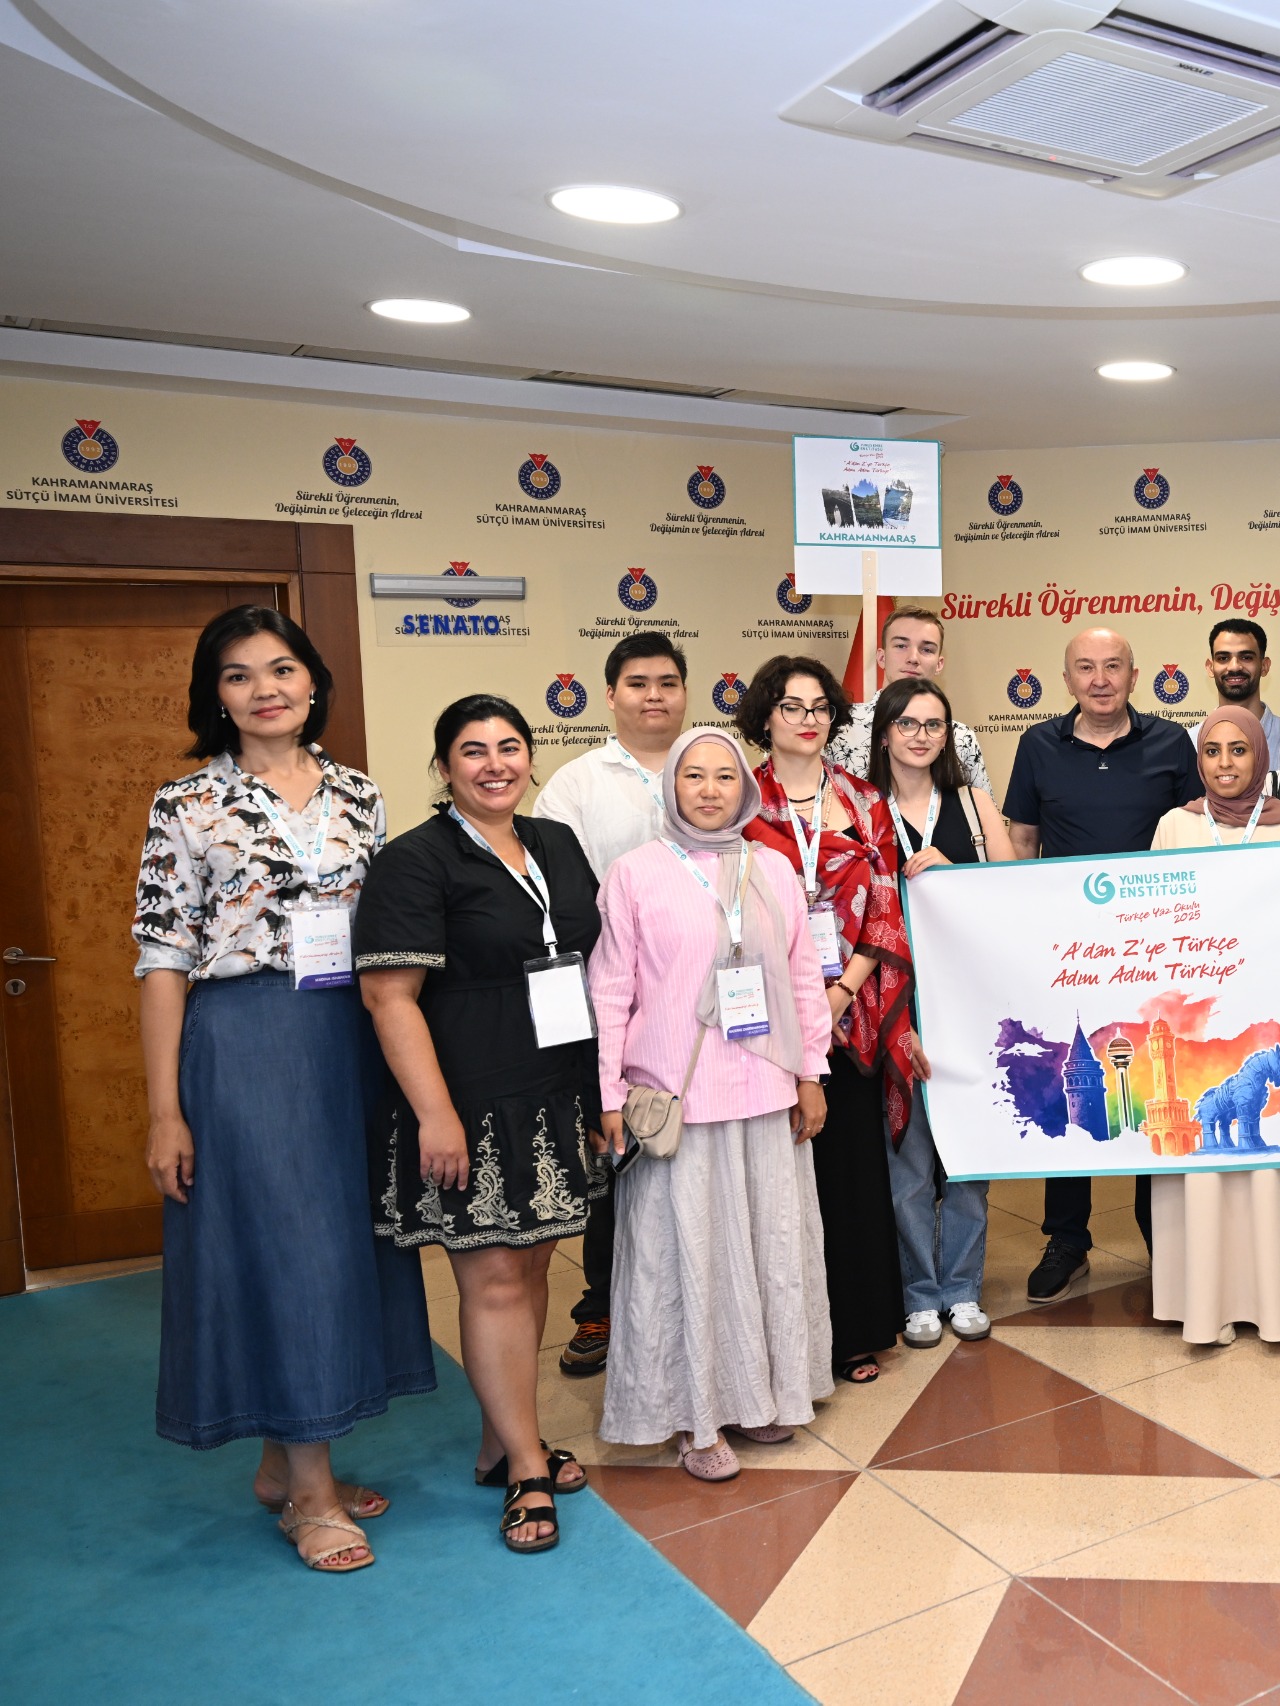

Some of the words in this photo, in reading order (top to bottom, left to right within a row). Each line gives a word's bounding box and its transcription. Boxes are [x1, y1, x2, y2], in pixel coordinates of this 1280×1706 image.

[32, 477, 153, 494] KAHRAMANMARAŞ
[7, 489, 49, 503] SÜTÇÜ
[54, 491, 91, 503] İMAM
[96, 494, 178, 508] ÜNİVERSİTESİ
[296, 491, 333, 502] Sürekli
[335, 491, 399, 506] Öğrenmenin,
[275, 503, 327, 516] Değişimin
[342, 506, 388, 520] Geleceğin
[391, 509, 422, 519] Adresi
[496, 504, 586, 518] KAHRAMANMARAŞ
[1115, 513, 1191, 523] KAHRAMANMARAŞ
[477, 514, 509, 526] SÜTÇÜ
[512, 516, 540, 526] İMAM
[543, 517, 605, 529] ÜNİVERSİTESİ
[666, 513, 695, 522] Sürekli
[697, 514, 746, 525] Öğrenmenin,
[969, 522, 995, 530] Sürekli
[650, 523, 690, 535] Değişimin
[702, 526, 738, 538] Geleceğin
[740, 528, 765, 537] Adresi
[1100, 526, 1125, 536] SÜTÇÜ
[1128, 526, 1151, 534] İMAM
[1154, 522, 1207, 533] ÜNİVERSİTESİ
[819, 532, 917, 544] KAHRAMANMARAŞ
[954, 533, 990, 543] Değişimin
[1001, 531, 1034, 541] Geleceğin
[1036, 530, 1060, 539] Adresi
[940, 592, 1032, 621] Sürekli
[1038, 583, 1203, 624] Öğrenmenin,
[403, 614, 500, 635] SENATO
[596, 617, 626, 626] Sürekli
[628, 615, 680, 629] Öğrenmenin,
[758, 619, 833, 629] KAHRAMANMARAŞ
[579, 628, 620, 639] Değişimin
[673, 629, 699, 639] Adresi
[742, 629, 769, 640] SÜTÇÜ
[771, 629, 795, 638] İMAM
[797, 629, 849, 639] ÜNİVERSİTESİ
[556, 721, 610, 735] Öğrenmenin,
[974, 724, 999, 734] SÜTÇÜ
[562, 736, 602, 746] Geleceğin
[1119, 873, 1160, 885] YUNUS
[1163, 871, 1196, 883] EMRE
[1120, 883, 1197, 898] ENSTİTÜSÜ
[1116, 911, 1150, 923] Türkçe
[1153, 906, 1172, 917] Yaz
[1174, 901, 1200, 913] Okulu
[1174, 911, 1201, 923] 2025
[1172, 936, 1239, 956] Türkçe
[1051, 969, 1100, 988] Adım
[1108, 965, 1158, 984] Adım
